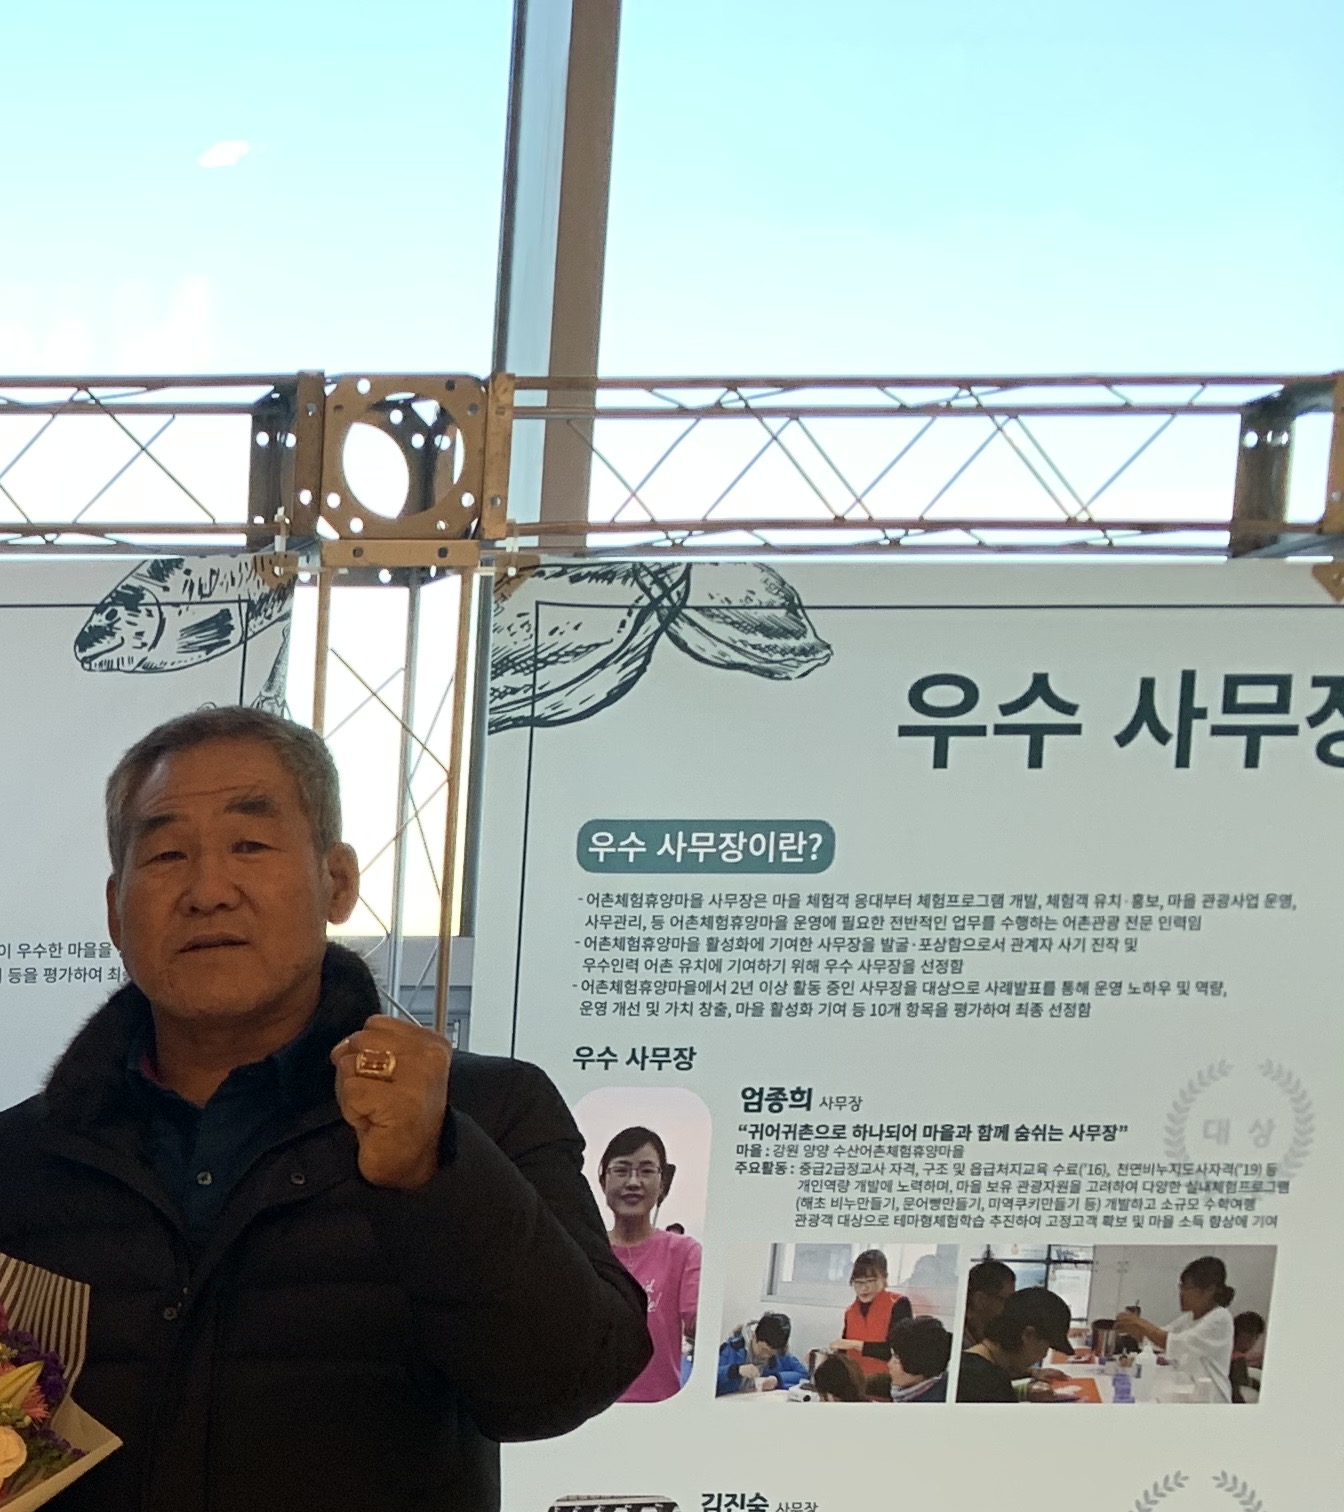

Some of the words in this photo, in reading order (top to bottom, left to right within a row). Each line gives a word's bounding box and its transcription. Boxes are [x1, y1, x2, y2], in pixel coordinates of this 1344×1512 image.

[898, 672, 1082, 769] 우수
[589, 831, 647, 862] 우수
[657, 831, 823, 862] 사무장이란?
[709, 893, 767, 909] 사무장은
[772, 893, 801, 909] 마을
[806, 893, 849, 909] 체험객
[855, 893, 912, 909] 응대부터
[1010, 894, 1042, 910] 개발,
[1046, 893, 1089, 909] 체험객
[1168, 893, 1196, 909] 마을
[1202, 893, 1259, 909] 관광사업
[1264, 893, 1296, 910] 운영,
[585, 914, 646, 931] 사무관리,
[794, 915, 836, 931] 운영에
[842, 915, 885, 931] 필요한
[890, 915, 947, 931] 전반적인
[952, 915, 995, 931] 업무를
[1001, 916, 1057, 931] 수행하는
[1063, 916, 1120, 931] 어촌관광
[1126, 915, 1152, 931] 전문
[1158, 916, 1201, 931] 인력임
[17, 942, 62, 959] 우수한
[68, 941, 112, 958] 마을을
[706, 936, 764, 952] 활성화에
[770, 937, 813, 952] 기여한
[818, 937, 875, 952] 사무장을
[1011, 937, 1053, 952] 관계자
[1058, 937, 1086, 953] 사기
[1092, 937, 1119, 952] 진작
[583, 958, 639, 973] 우수인력
[644, 958, 673, 973] 어촌
[679, 958, 722, 973] 유치에
[728, 958, 786, 974] 기여하기
[791, 959, 819, 974] 위해
[825, 959, 853, 974] 우수
[858, 959, 915, 974] 사무장을
[921, 959, 963, 974] 선정함
[9, 967, 37, 984] 등을
[44, 967, 102, 983] 평가하여
[731, 980, 753, 995] 2년
[759, 980, 788, 996] 이상
[793, 980, 821, 996] 활동
[827, 980, 854, 996] 중인
[860, 980, 917, 996] 사무장을
[922, 981, 979, 996] 대상으로
[985, 981, 1056, 996] 사례발표를
[1062, 981, 1089, 996] 통해
[1095, 981, 1122, 996] 운영
[1128, 981, 1171, 996] 노하우
[1195, 981, 1226, 997] 역량,
[580, 1001, 607, 1016] 운영
[613, 1001, 640, 1016] 개선
[665, 1001, 693, 1017] 가치
[699, 1002, 731, 1018] 창출,
[736, 1002, 764, 1017] 마을
[771, 1002, 813, 1017] 활성화
[818, 1002, 847, 1017] 기여
[870, 1002, 901, 1017] 10개
[906, 1002, 948, 1018] 항목을
[954, 1002, 1010, 1018] 평가하여
[1016, 1002, 1043, 1018] 최종
[1049, 1002, 1091, 1018] 선정함
[573, 1046, 618, 1071] 우수
[625, 1044, 696, 1073] 사무장
[741, 1086, 812, 1113] 엄종희
[819, 1096, 863, 1112] 사무장
[738, 1123, 846, 1141] “귀어귀촌으로
[852, 1124, 917, 1141] 하나되어
[923, 1124, 972, 1141] 마을과
[978, 1124, 1009, 1141] 함께
[1015, 1124, 1063, 1141] 숨쉬는
[1069, 1124, 1128, 1141] 사무장”
